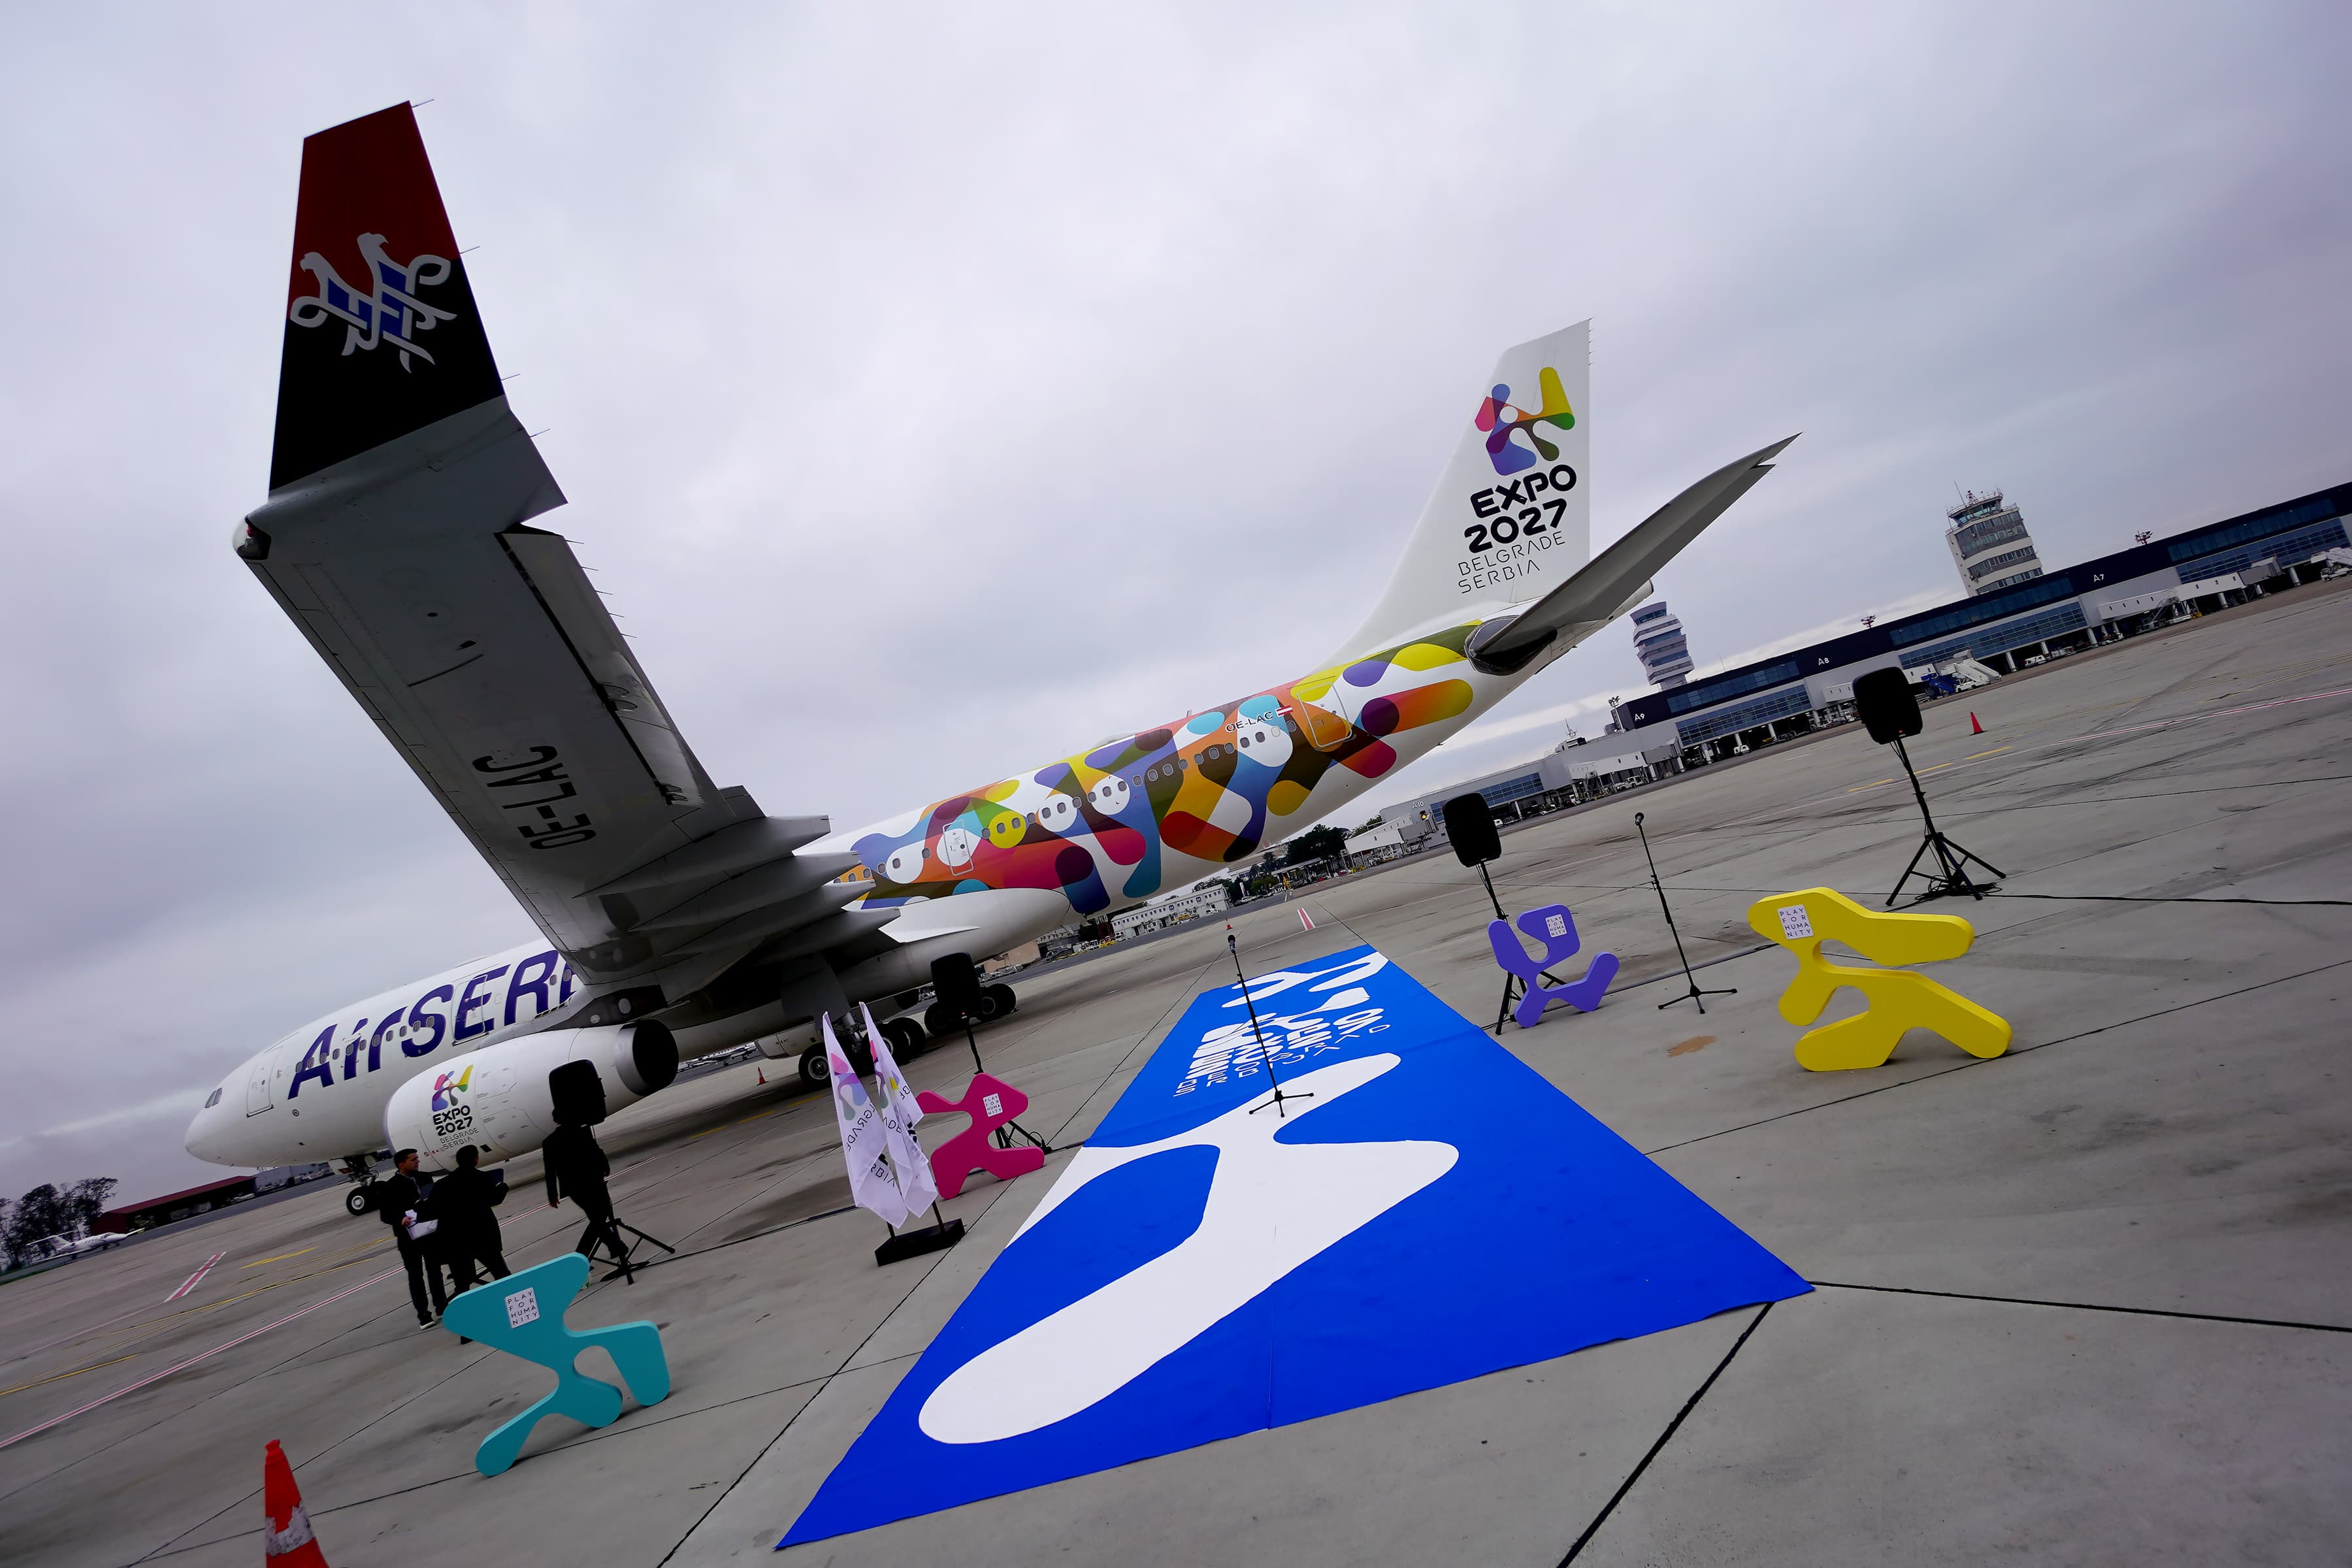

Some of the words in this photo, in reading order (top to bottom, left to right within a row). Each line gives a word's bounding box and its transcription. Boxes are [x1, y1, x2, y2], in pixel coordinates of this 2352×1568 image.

[1470, 464, 1577, 519] EXPO
[1463, 498, 1567, 554] 2027
[1458, 531, 1565, 576] BELGRADE
[1458, 560, 1541, 594] SERBIA
[2093, 574, 2104, 583] A7
[1818, 657, 1830, 666] A8
[1226, 711, 1273, 732] OE-LAC
[1635, 713, 1645, 722] A9
[472, 745, 596, 849] OE-LAC
[1411, 800, 1425, 809] A10
[1780, 908, 1803, 917] PLAY
[1782, 915, 1806, 923] FOR
[1190, 1008, 1384, 1069] EXPO
[1186, 1015, 1382, 1079] 2027
[433, 1105, 470, 1125] EXPO
[436, 1116, 473, 1136] 2027
[440, 1128, 480, 1144] BELGRADE
[443, 1137, 474, 1149] SERBIA
[508, 1291, 532, 1304] PLAY
[510, 1298, 534, 1311] FOR
[512, 1305, 536, 1318] HUMA
[513, 1312, 536, 1325] NITY
